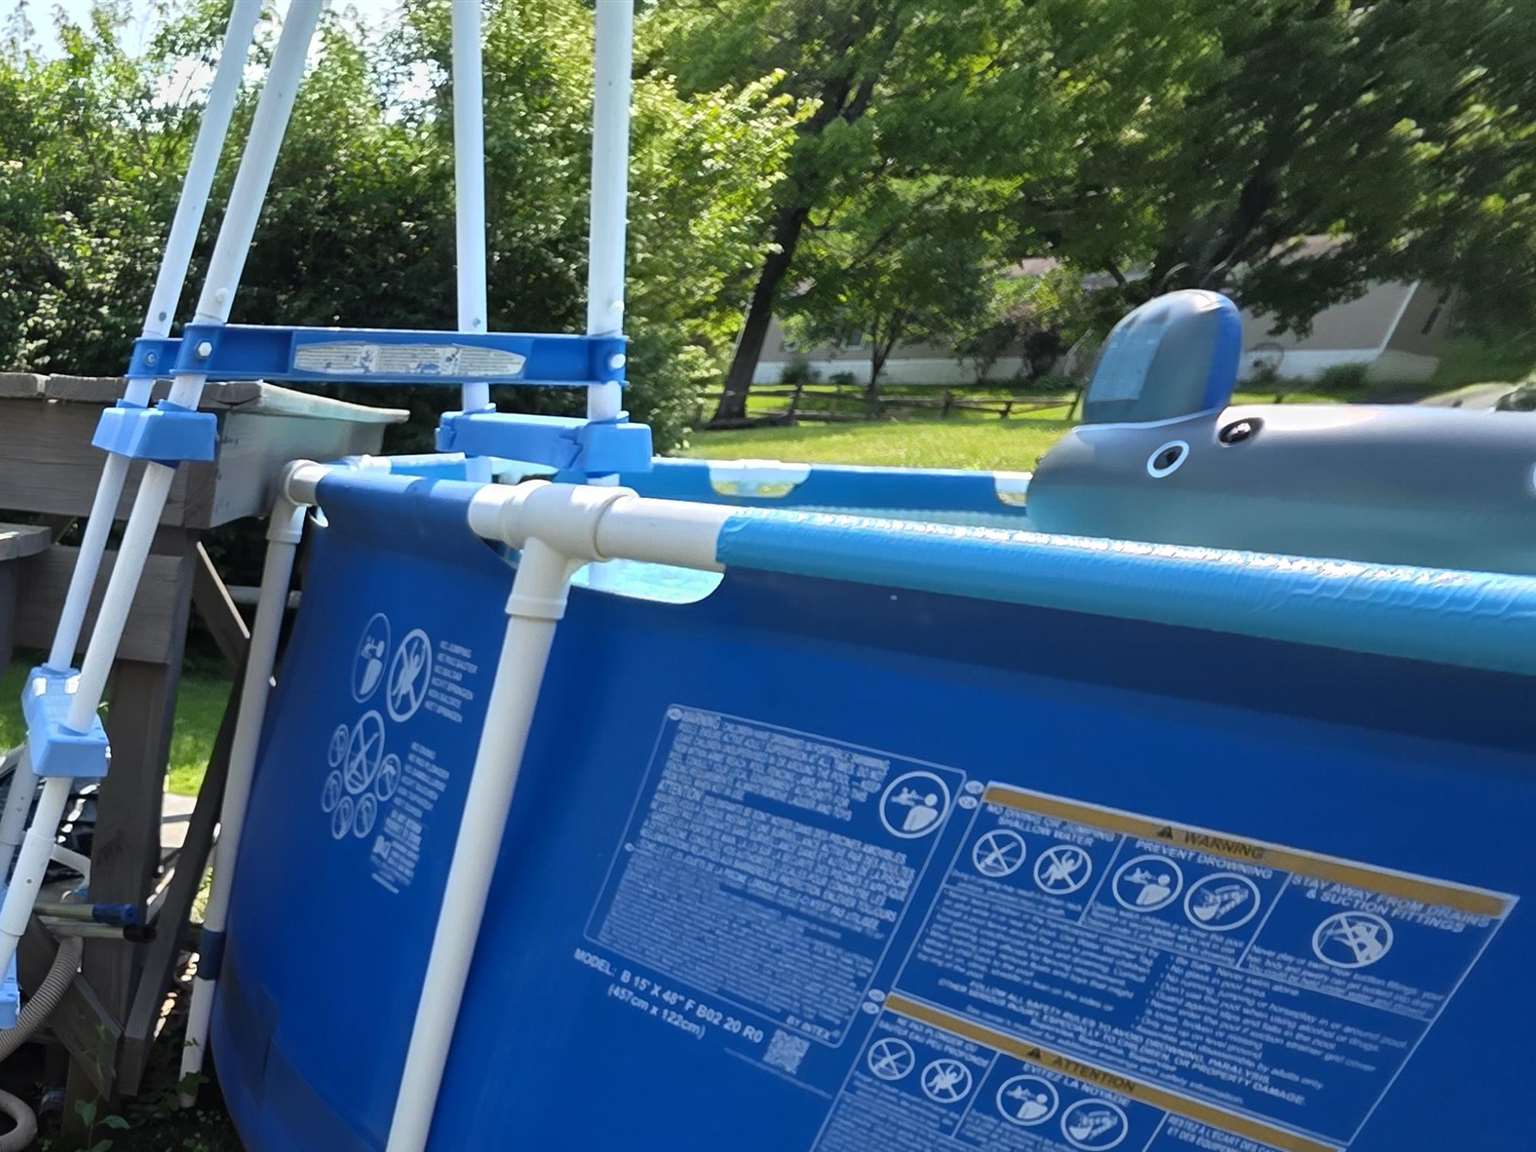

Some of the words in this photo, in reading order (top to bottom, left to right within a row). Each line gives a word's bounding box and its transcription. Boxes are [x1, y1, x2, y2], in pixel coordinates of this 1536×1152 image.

[998, 815, 1052, 836] SHALLOW
[1053, 828, 1093, 846] WATER
[1184, 830, 1264, 859] WARNING
[1135, 838, 1192, 860] PREVENT
[1197, 853, 1272, 879] DROWNING
[1292, 873, 1328, 890] STAY
[1331, 882, 1371, 900] AWAY
[1376, 893, 1423, 913] FROM
[1426, 904, 1490, 928] DRAINS
[1306, 887, 1317, 899] &
[1320, 891, 1387, 915] SUCTION
[1392, 908, 1463, 934] FITTINGS
[607, 983, 649, 1012] (457cm
[649, 1005, 660, 1017] x
[663, 1008, 707, 1040] 122cm)
[620, 970, 631, 983] B
[651, 983, 662, 996] X
[685, 999, 696, 1012] F
[696, 1003, 723, 1026] B02
[723, 1016, 743, 1034] 20
[785, 1015, 801, 1028] BY
[1052, 1055, 1136, 1094] ATTENTION
[1063, 1076, 1082, 1089] LA
[1080, 1082, 1130, 1107] NOYADE
